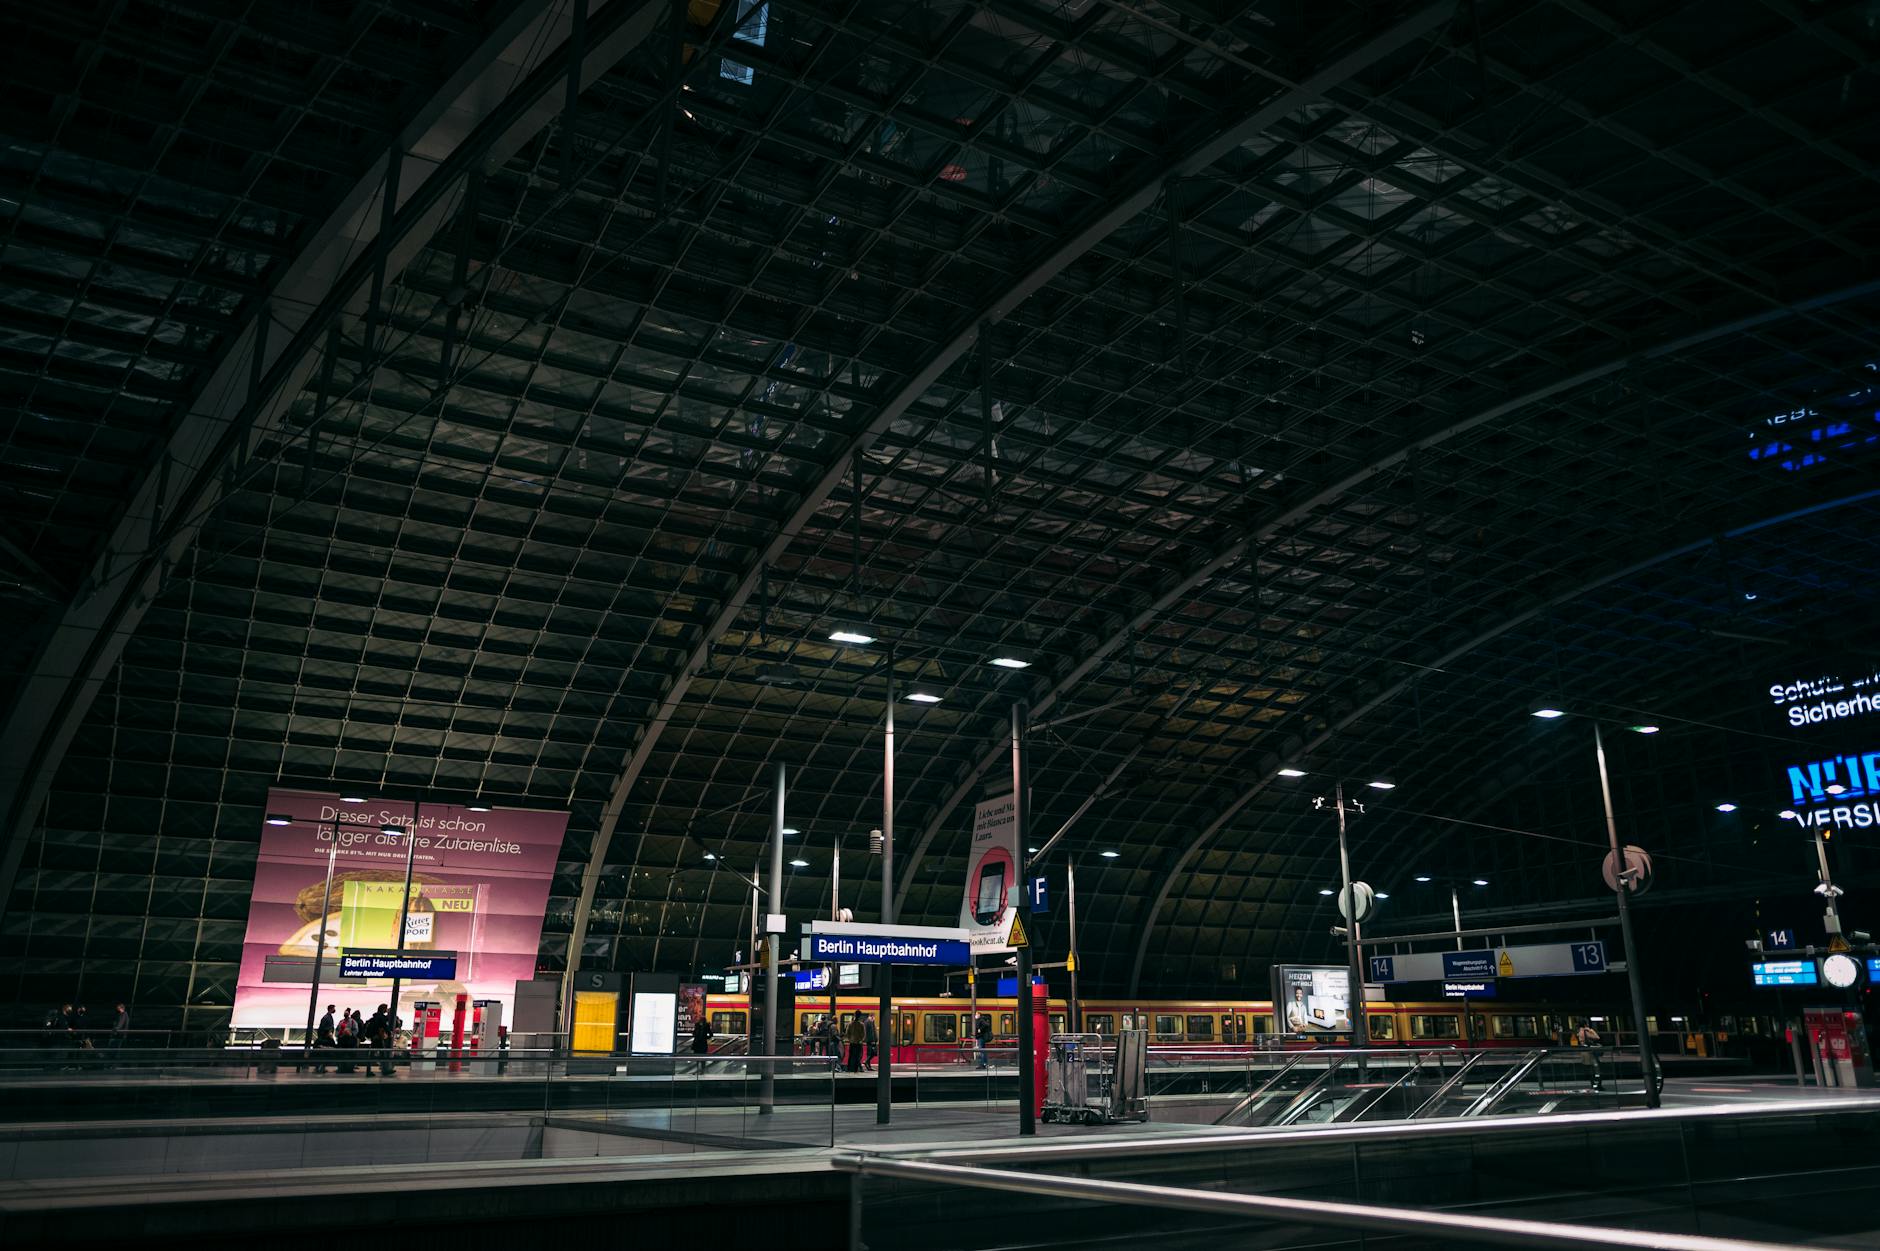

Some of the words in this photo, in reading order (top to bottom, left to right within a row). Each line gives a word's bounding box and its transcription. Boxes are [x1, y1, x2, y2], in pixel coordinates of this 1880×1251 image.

[320, 805, 375, 824] Dieser
[378, 810, 415, 827] Satz
[419, 815, 435, 829] ist
[438, 815, 486, 833] schon
[316, 824, 372, 847] länger
[375, 832, 397, 846] als
[402, 831, 430, 848] ihre
[434, 834, 522, 854] Zutatenliste.
[366, 885, 418, 894] KAKAO
[1035, 877, 1046, 905] F
[442, 900, 470, 911] NEU
[969, 936, 1005, 946] ookBeat.de
[1770, 930, 1788, 946] 14
[818, 939, 854, 954] Berlin
[856, 940, 938, 958] Hauptbahnhof
[1578, 944, 1600, 965] 13
[345, 957, 371, 968] Berlin
[372, 959, 432, 970] Hauptbahnhof
[1373, 959, 1388, 976] 14
[591, 974, 603, 988] S
[1068, 1053, 1074, 1062] 2
